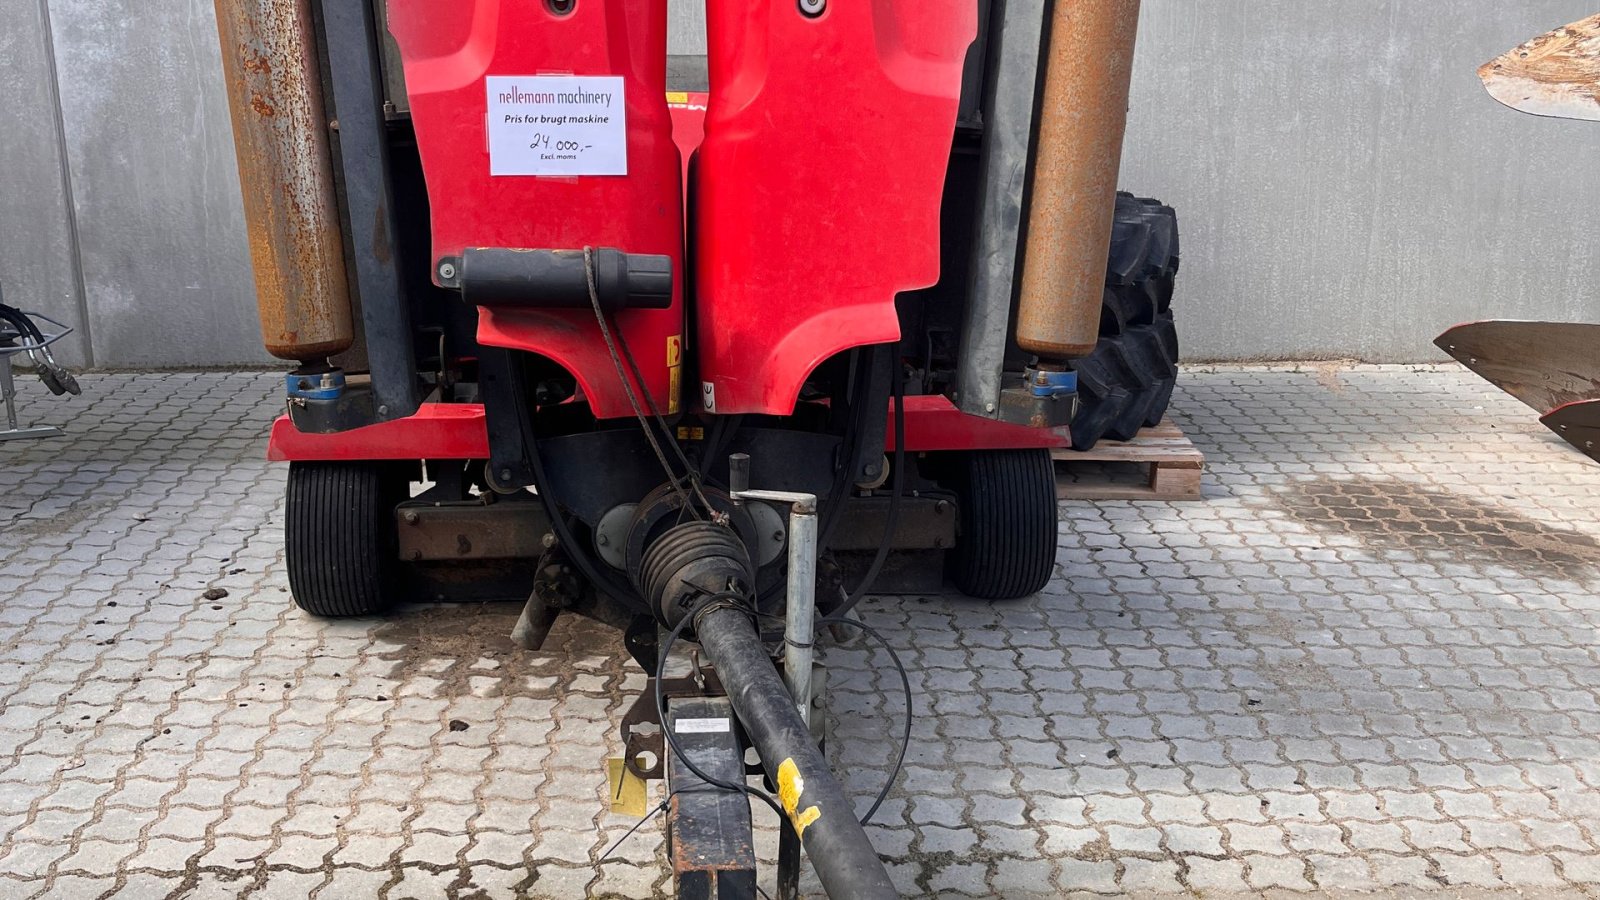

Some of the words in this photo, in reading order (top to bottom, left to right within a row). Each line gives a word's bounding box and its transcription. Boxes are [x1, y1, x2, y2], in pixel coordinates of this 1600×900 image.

[499, 85, 555, 104] nellemann
[557, 86, 612, 107] machinery
[504, 114, 523, 123] Pris
[524, 114, 539, 123] for
[540, 114, 567, 125] brugt
[568, 114, 609, 124] maskine
